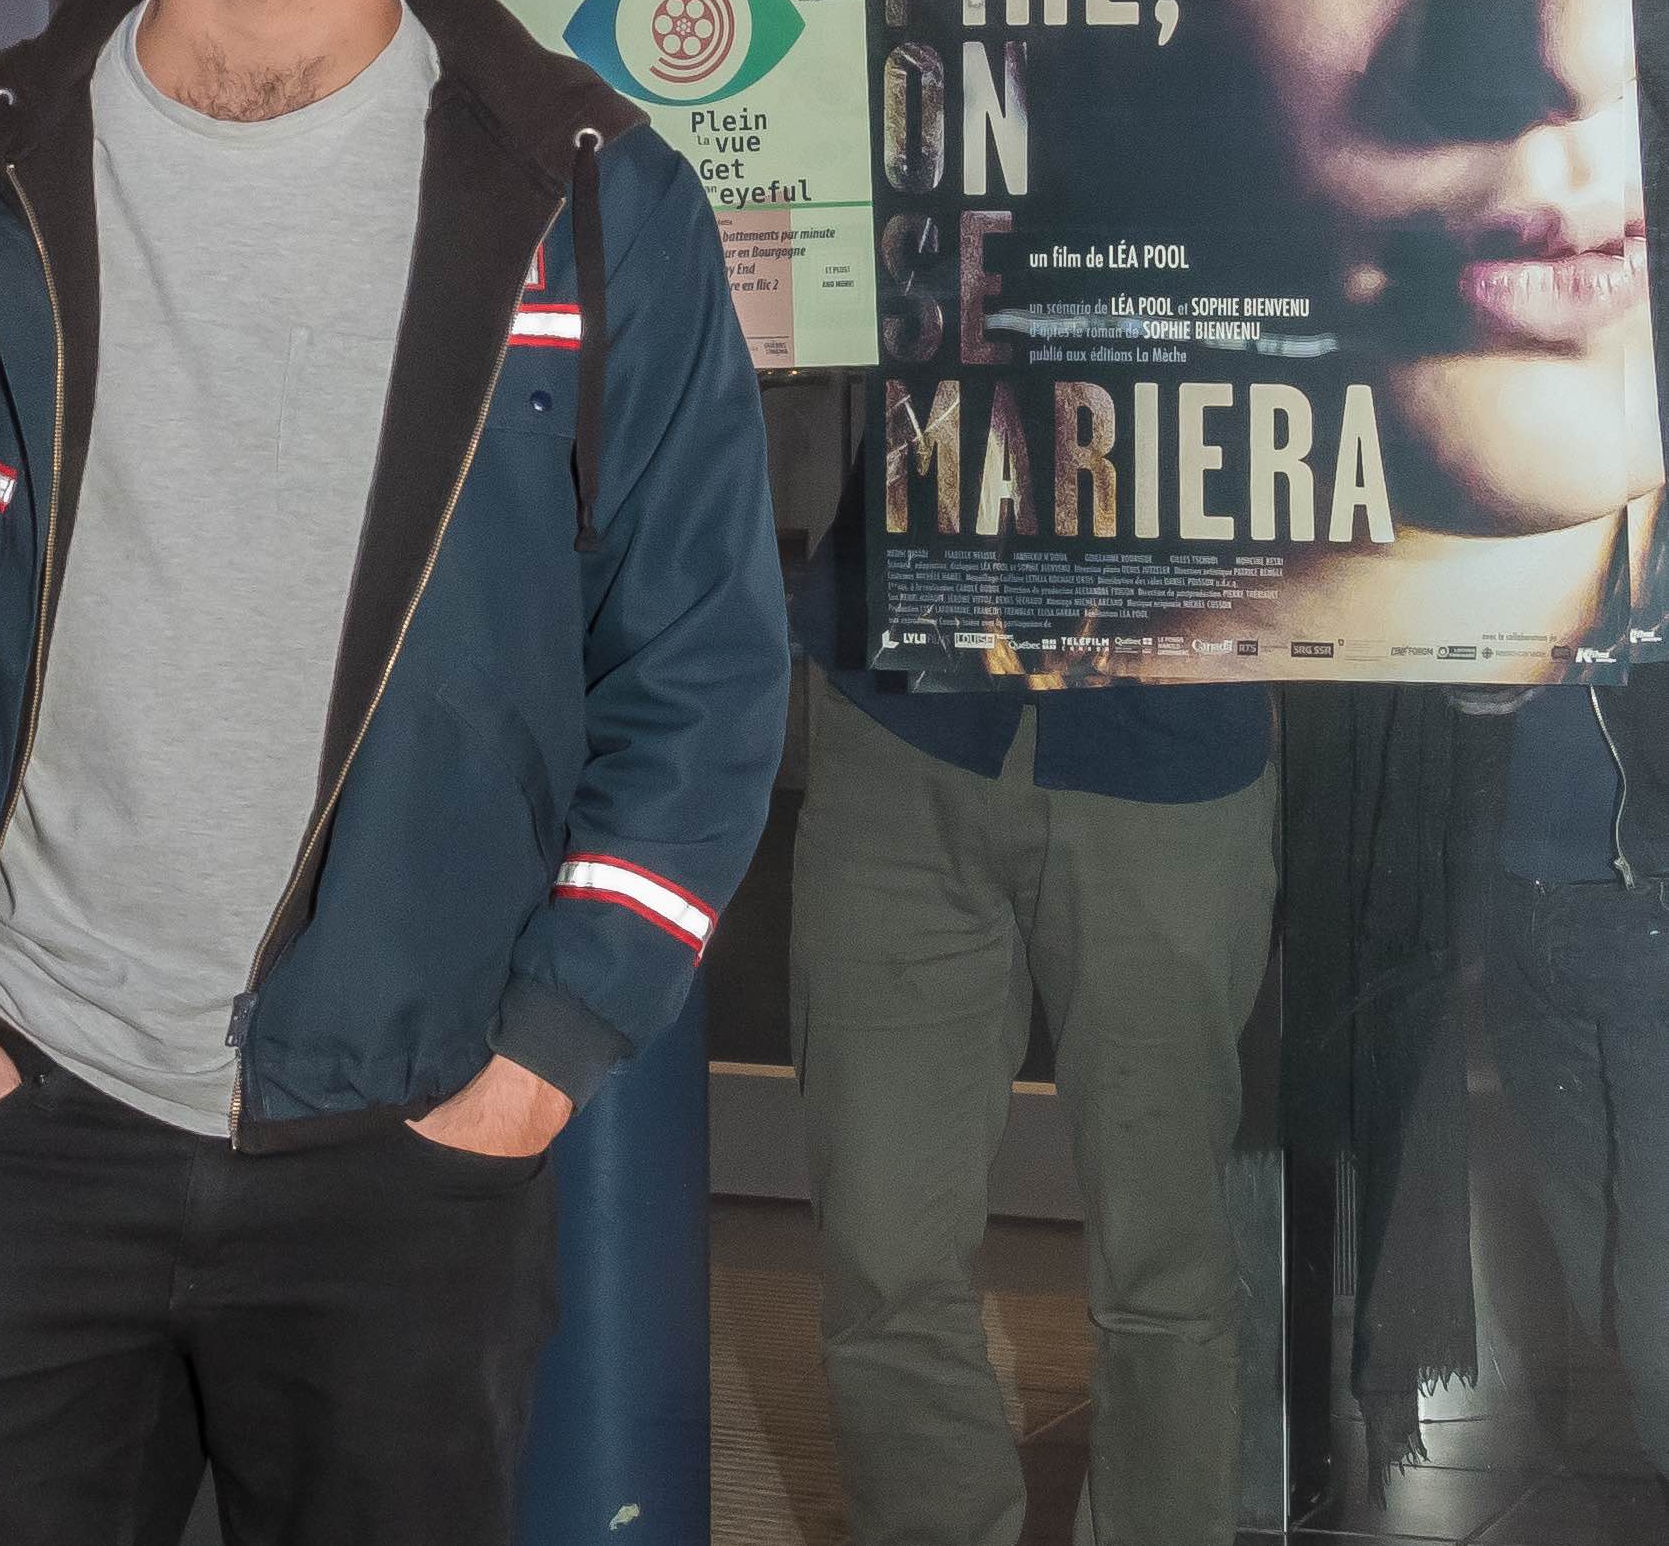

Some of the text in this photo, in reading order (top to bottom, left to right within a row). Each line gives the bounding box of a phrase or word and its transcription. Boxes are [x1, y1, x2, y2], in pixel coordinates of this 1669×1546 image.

[691, 107, 768, 133] Plein
[883, 40, 1028, 196] ON
[715, 134, 761, 153] vue
[699, 158, 745, 181] Get
[720, 179, 812, 210] eyeful
[722, 229, 779, 243] battements
[799, 227, 836, 240] minute
[752, 245, 807, 260] Bourgogne
[1029, 240, 1190, 269] un film de LÉA POOL
[772, 278, 779, 291] 2
[881, 210, 1014, 365] SE
[1029, 293, 1310, 318] un scénario de LÉA POOL et SOPHIE BIENVENU
[1086, 326, 1123, 338] roman
[1142, 320, 1191, 340] SOPHIE
[1195, 321, 1261, 341] BIENVENU
[1029, 345, 1187, 364] publié aux éditions La Mèche
[885, 379, 1396, 544] MARIERA
